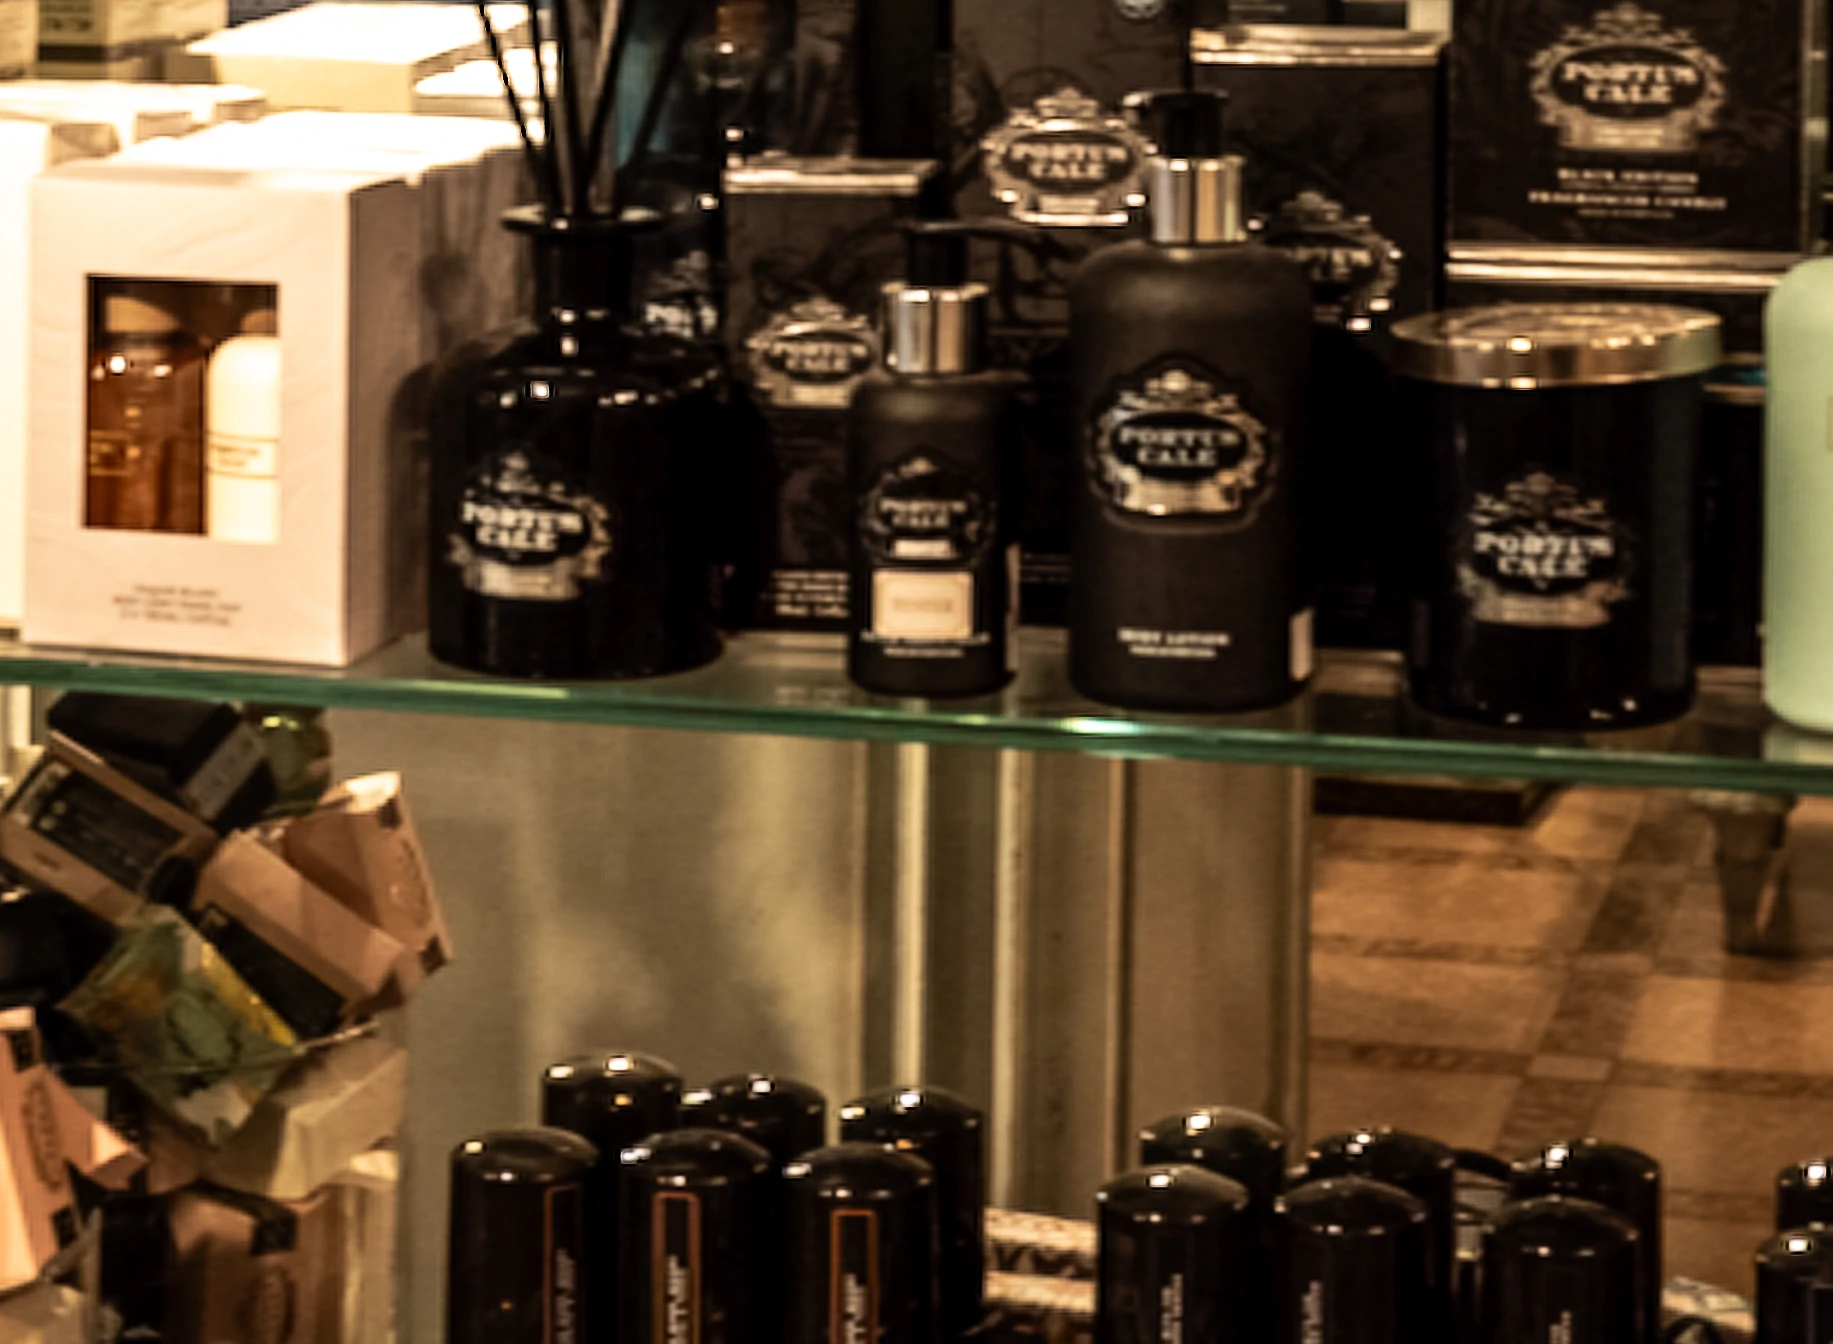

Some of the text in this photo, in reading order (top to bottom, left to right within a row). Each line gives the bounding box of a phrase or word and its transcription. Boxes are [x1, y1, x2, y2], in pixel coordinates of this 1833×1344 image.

[1561, 62, 1699, 85] PORTUS
[1581, 82, 1672, 105] CALE
[1009, 141, 1128, 162] PORTUS
[1028, 160, 1107, 179] CALE
[1117, 426, 1240, 448] PORTUS
[1136, 445, 1217, 467] CALE
[462, 500, 584, 534] PORTUS
[475, 526, 560, 552] CALE
[1472, 531, 1615, 558] PORTUS
[1496, 554, 1588, 578] CALE
